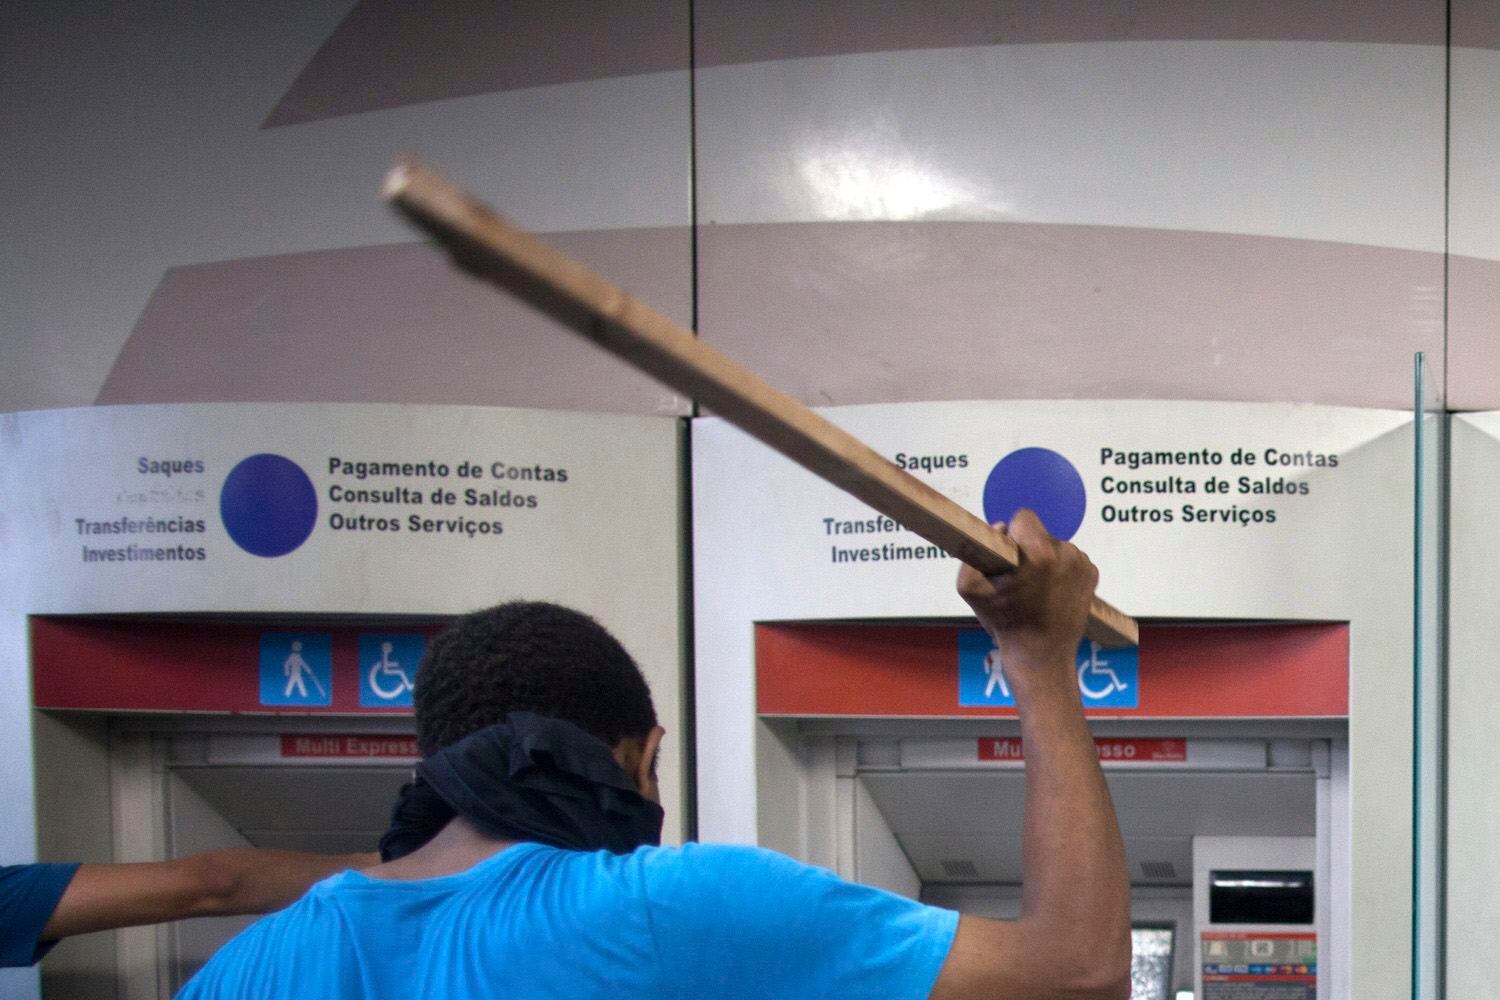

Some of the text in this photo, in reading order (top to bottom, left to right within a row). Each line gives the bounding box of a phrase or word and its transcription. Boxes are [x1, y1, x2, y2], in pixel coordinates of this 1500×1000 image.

[137, 456, 205, 478] Saques
[896, 453, 969, 473] Saques
[1100, 447, 1339, 470] Pagamento de Contas
[329, 457, 568, 483] Pagamento de Contas
[329, 485, 538, 508] Consulta de Saldos
[1100, 476, 1310, 496] Consulta de Saldos
[75, 516, 206, 535] Transferências
[329, 513, 503, 538] Outros Serviços
[823, 516, 911, 535] Transfer
[1101, 504, 1277, 527] Outros Serviços
[82, 544, 206, 563] Investimentos
[832, 543, 957, 563] Investiment
[295, 736, 418, 757] Multi Express
